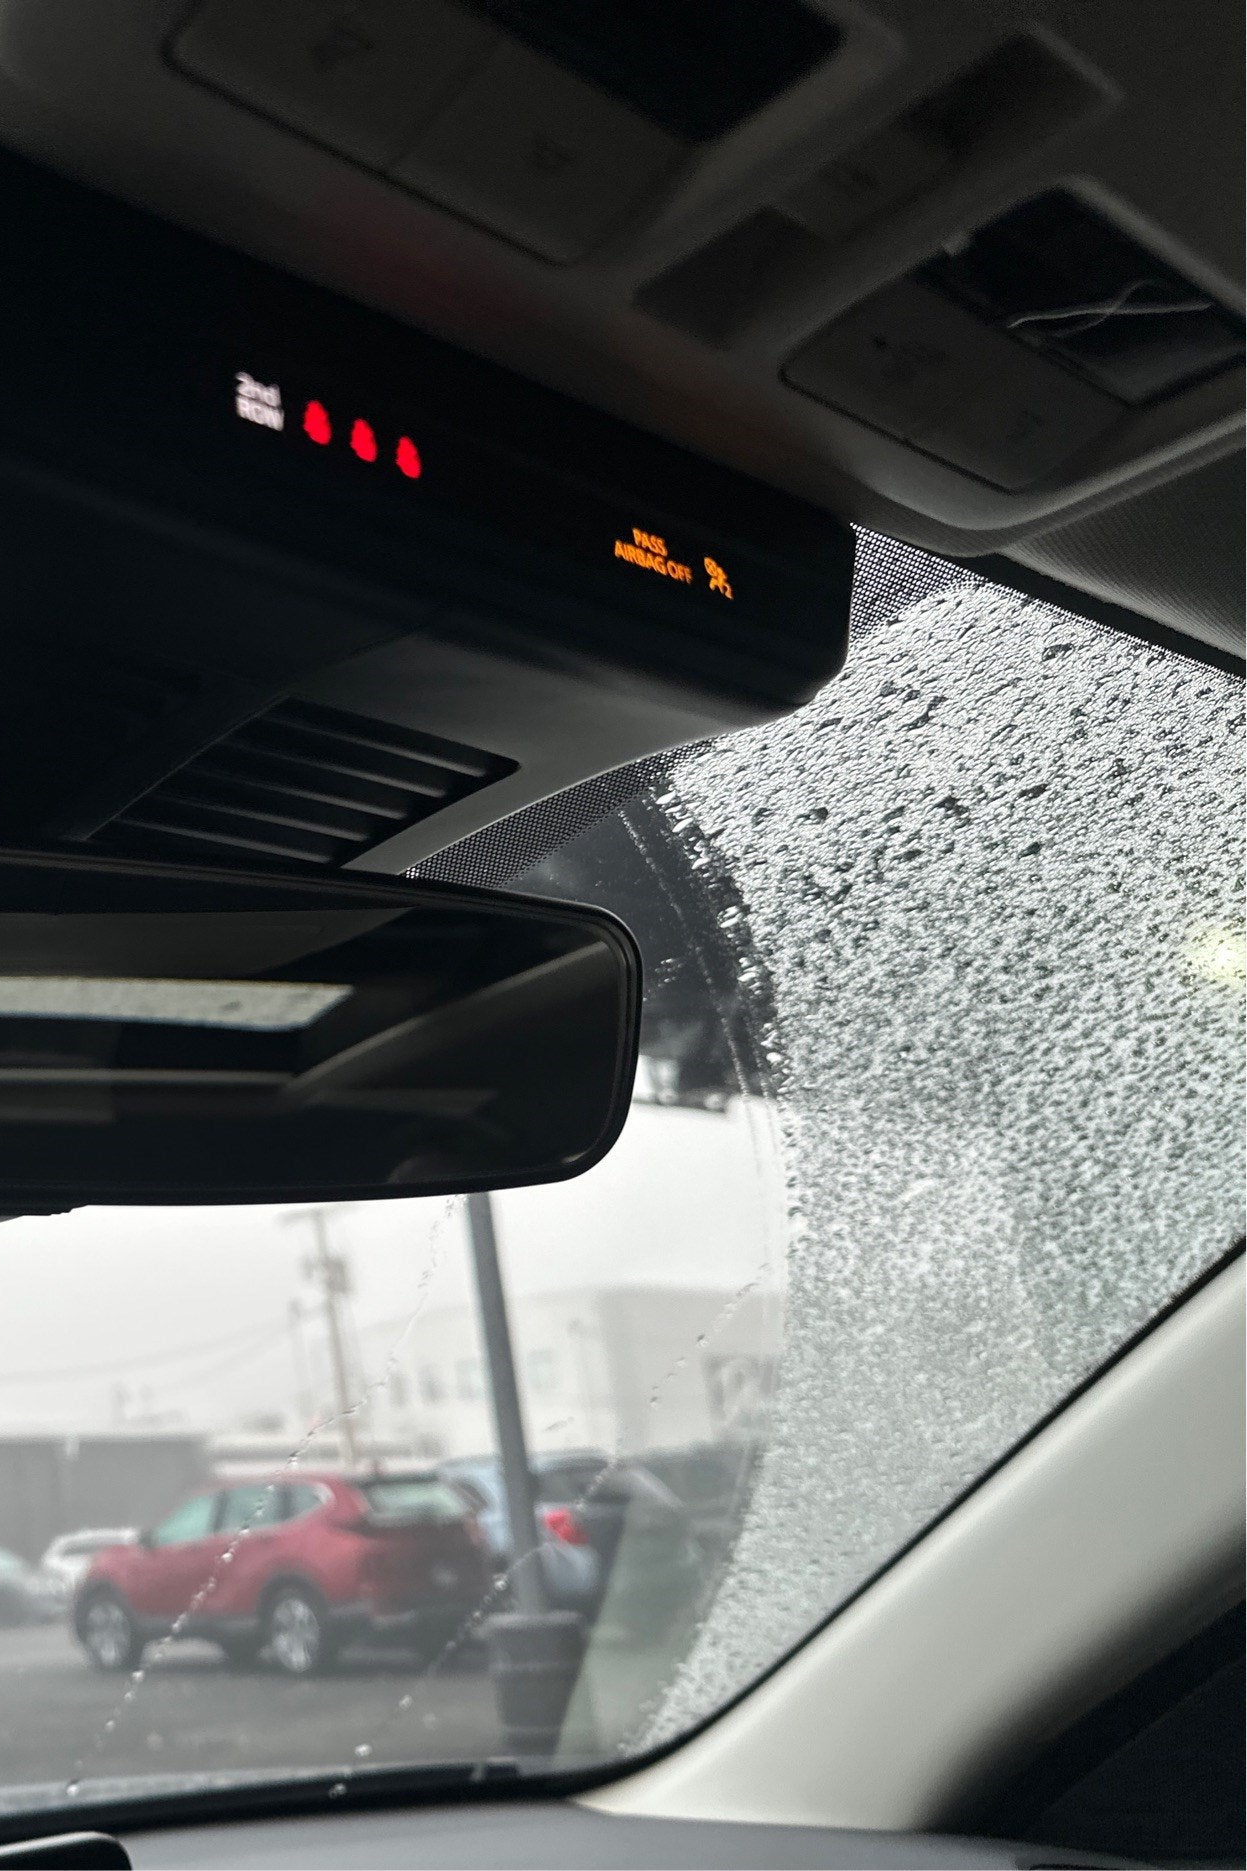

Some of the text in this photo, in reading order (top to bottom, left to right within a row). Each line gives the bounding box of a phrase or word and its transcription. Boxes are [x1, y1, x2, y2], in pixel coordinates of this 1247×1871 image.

[235, 371, 281, 407] 2nd
[236, 396, 284, 431] ROW
[632, 528, 667, 557] PASS
[615, 540, 692, 584] AIRBAG OFF
